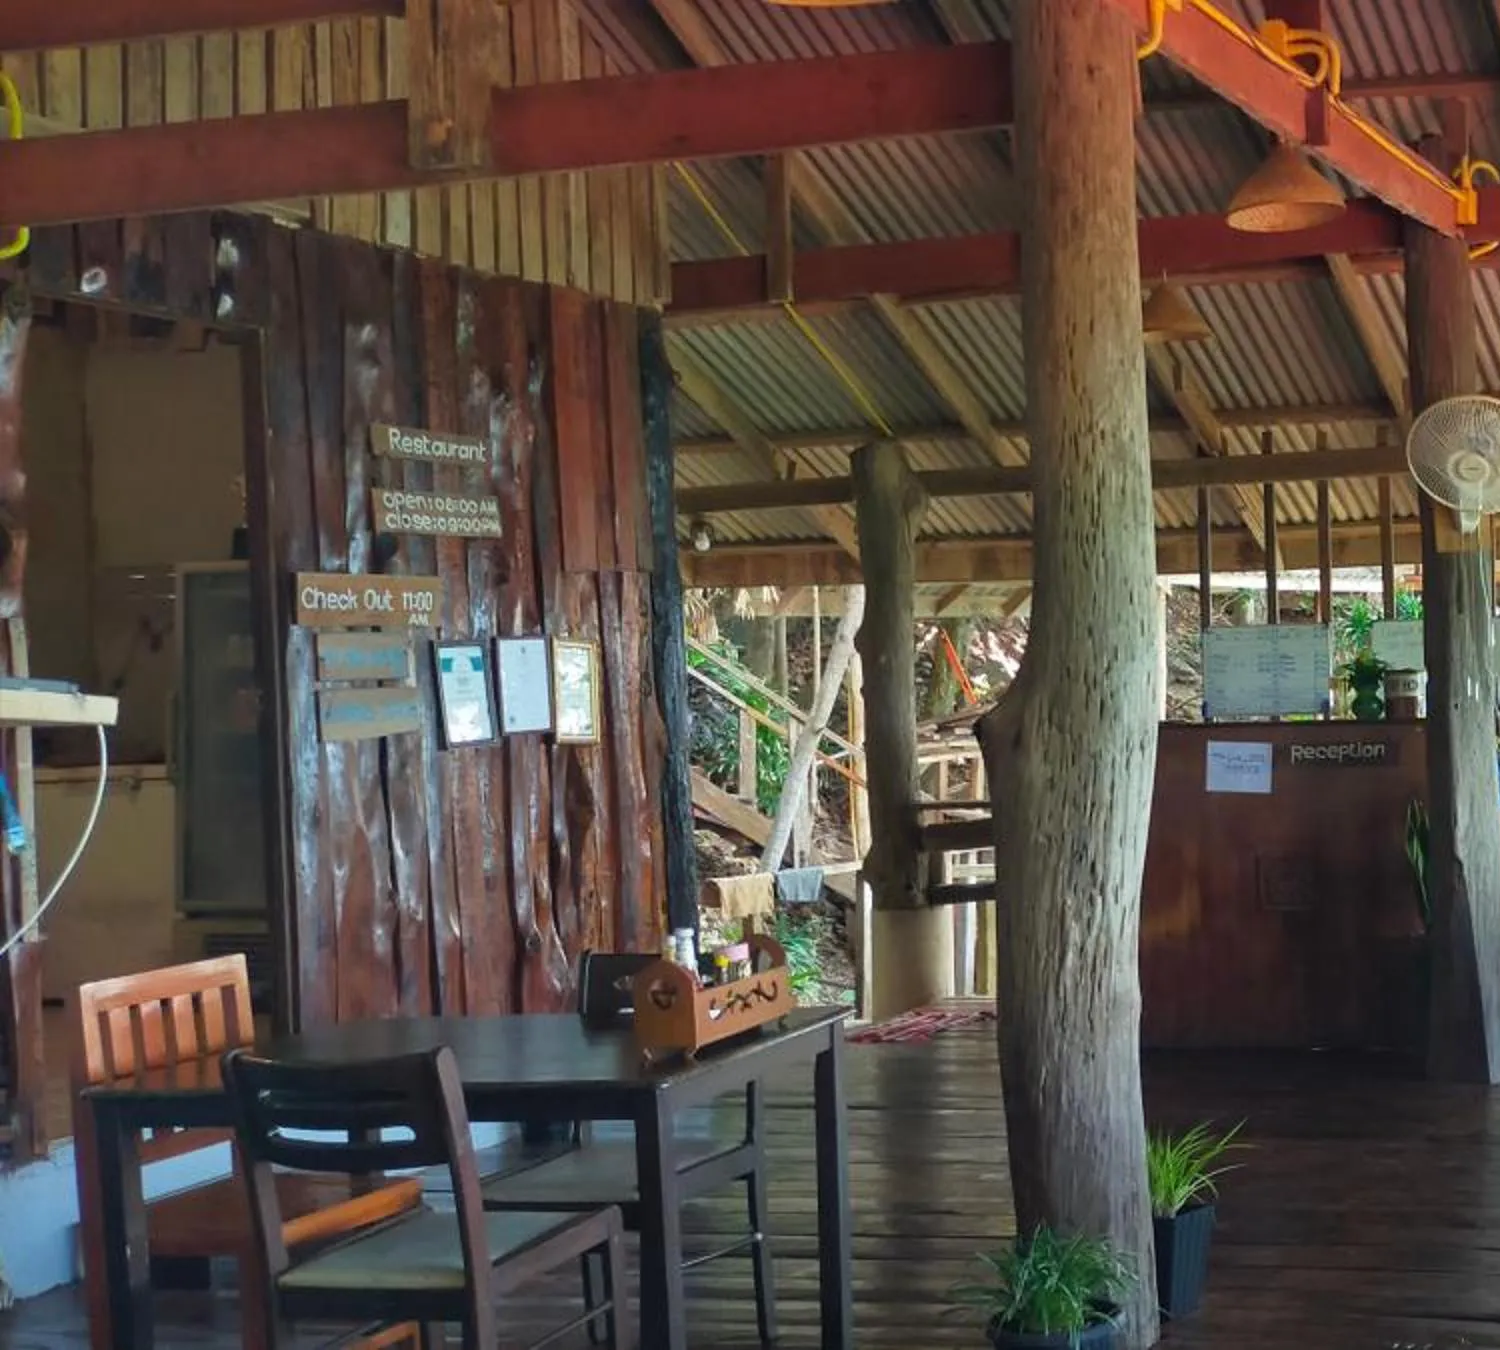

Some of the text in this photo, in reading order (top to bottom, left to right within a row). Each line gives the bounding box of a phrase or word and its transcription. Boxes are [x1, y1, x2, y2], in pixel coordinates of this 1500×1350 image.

[388, 427, 486, 462] Restaurant
[302, 586, 433, 611] Check Out 11:00
[408, 613, 429, 625] AM
[1290, 741, 1385, 764] Reception
